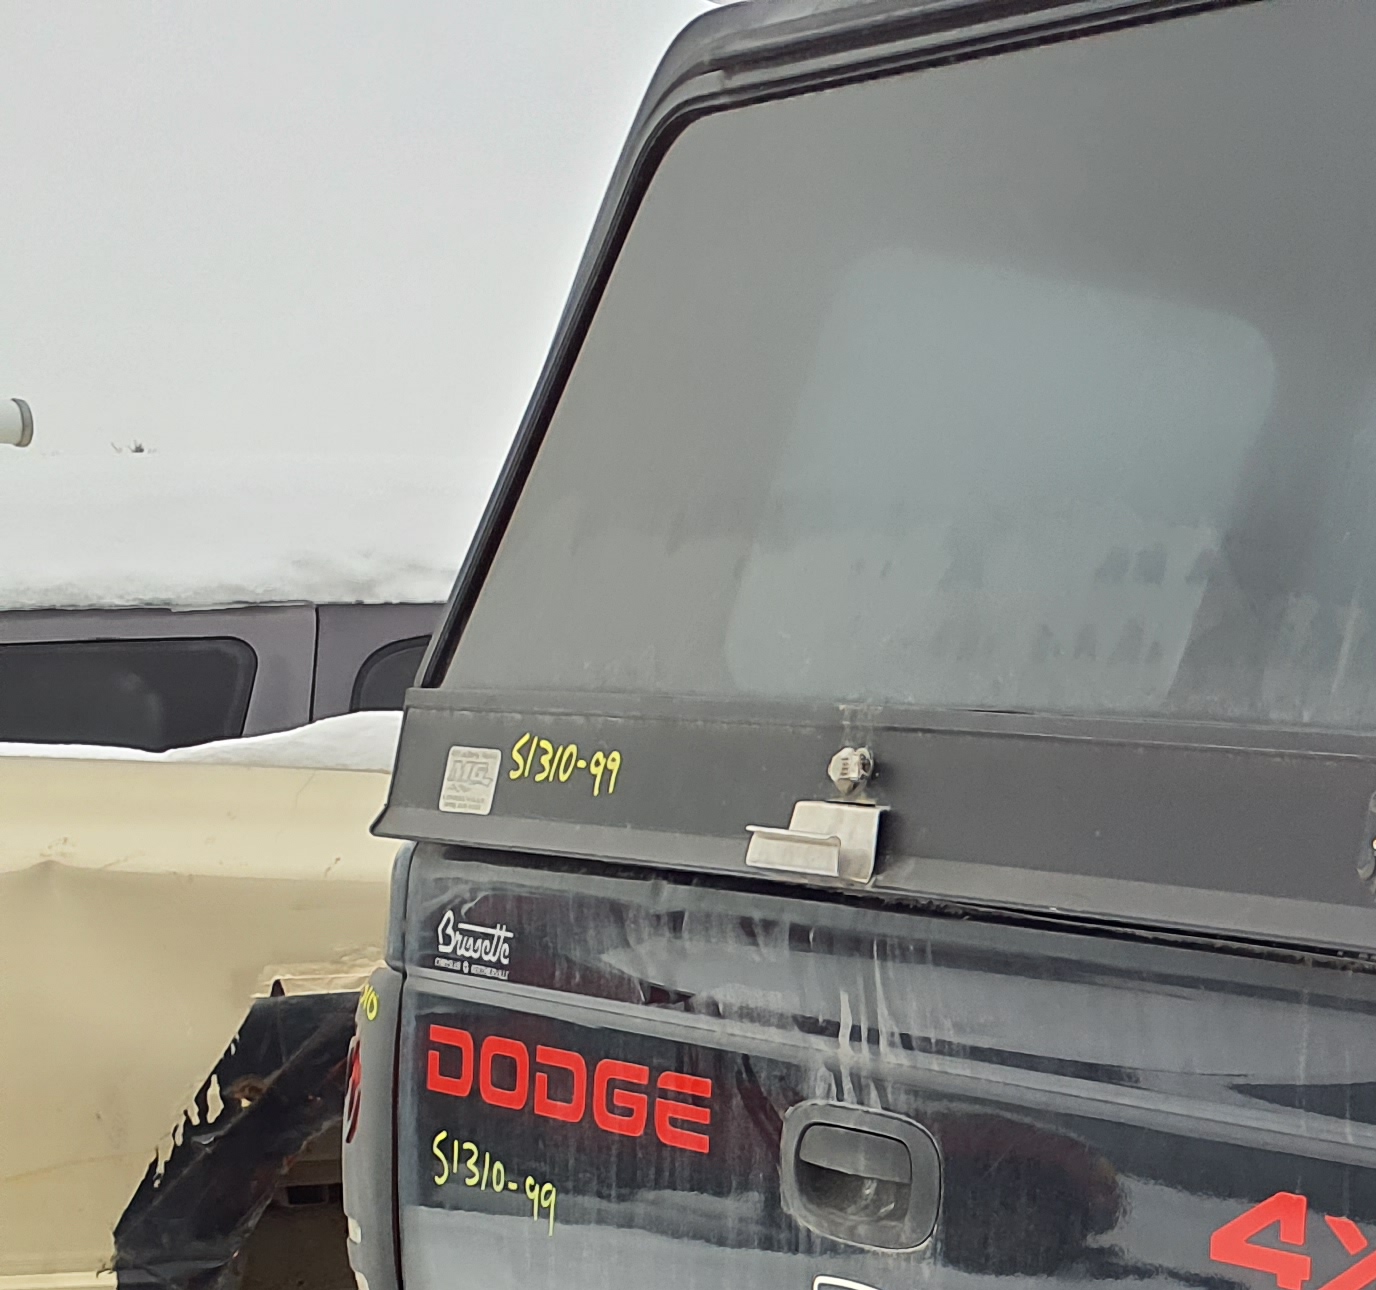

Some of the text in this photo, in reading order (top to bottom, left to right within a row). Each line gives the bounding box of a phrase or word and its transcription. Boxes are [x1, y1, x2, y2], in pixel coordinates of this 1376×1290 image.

[508, 732, 621, 797] S1310-99
[426, 1023, 712, 1154] DODGE
[432, 1130, 557, 1237] S1310-99
